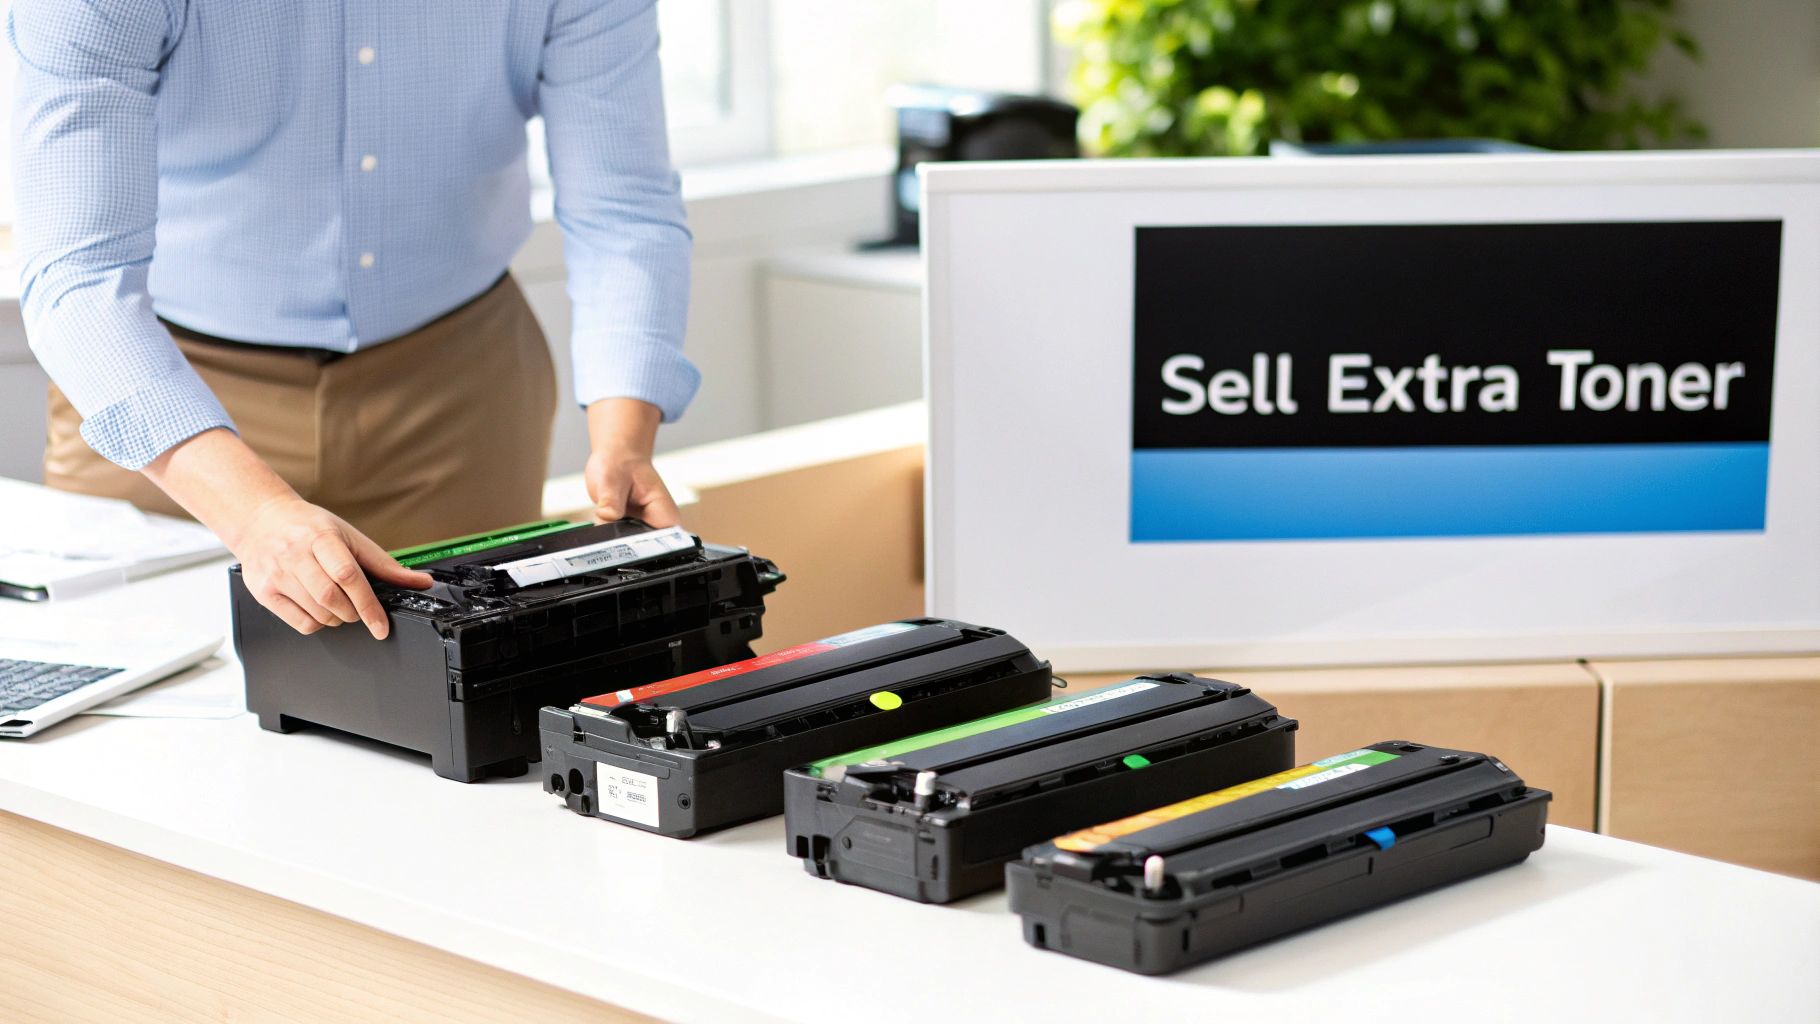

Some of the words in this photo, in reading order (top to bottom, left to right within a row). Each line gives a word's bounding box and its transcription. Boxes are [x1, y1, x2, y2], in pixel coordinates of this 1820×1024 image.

[1162, 354, 1297, 414] Sell
[1328, 354, 1518, 412] Extra
[1547, 351, 1743, 411] Toner
